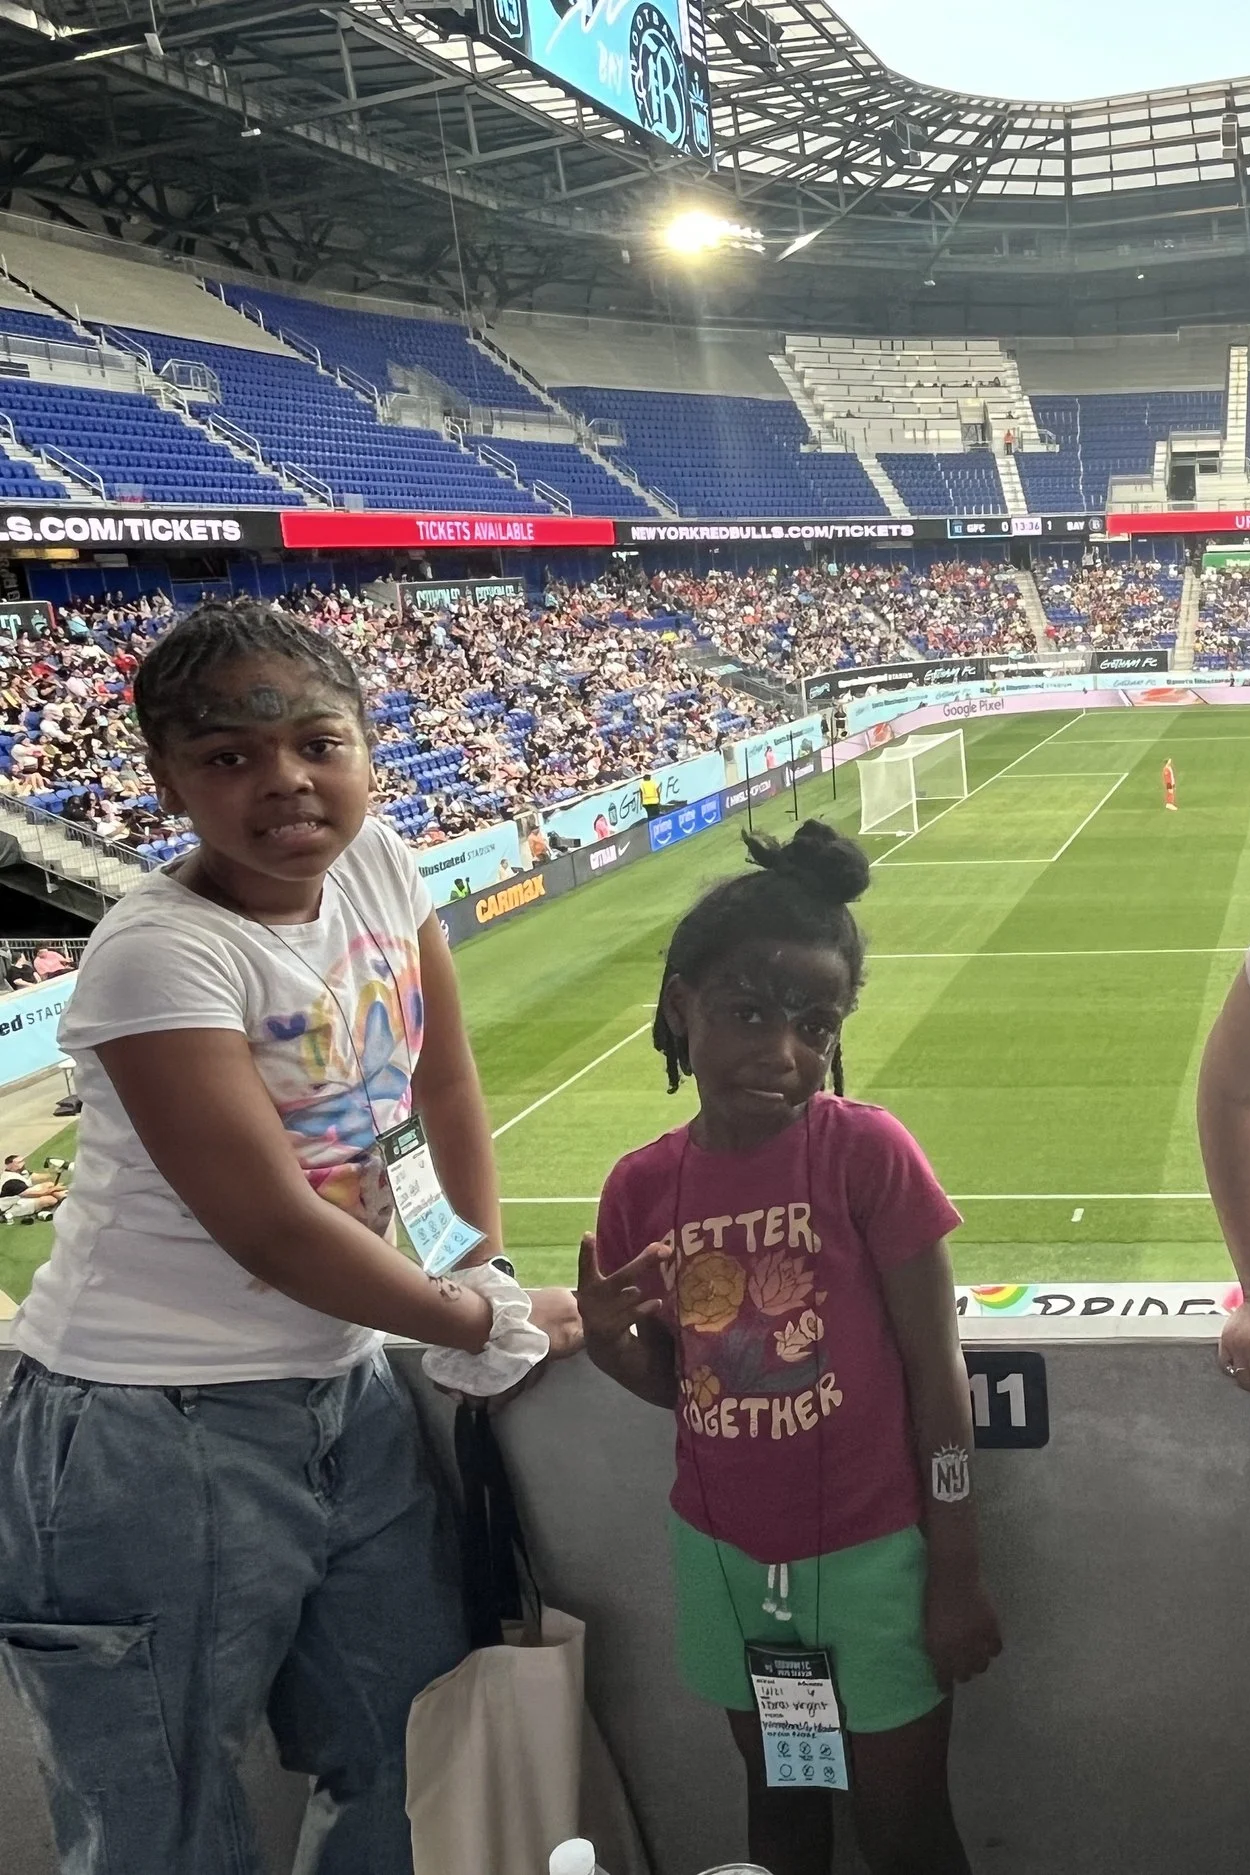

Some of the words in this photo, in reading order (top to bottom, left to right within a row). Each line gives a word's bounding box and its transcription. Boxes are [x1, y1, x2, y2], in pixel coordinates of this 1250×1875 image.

[416, 520, 471, 541] TICKETS
[474, 522, 534, 541] AVAILABLE
[631, 523, 914, 541] NEWYORKREDBULLS.COM/TICKETS
[1066, 521, 1085, 531] BAY
[1141, 657, 1158, 668] FC
[943, 702, 978, 718] Google
[979, 698, 1005, 712] Pixel
[666, 775, 681, 798] FC
[26, 1001, 66, 1025] STAD
